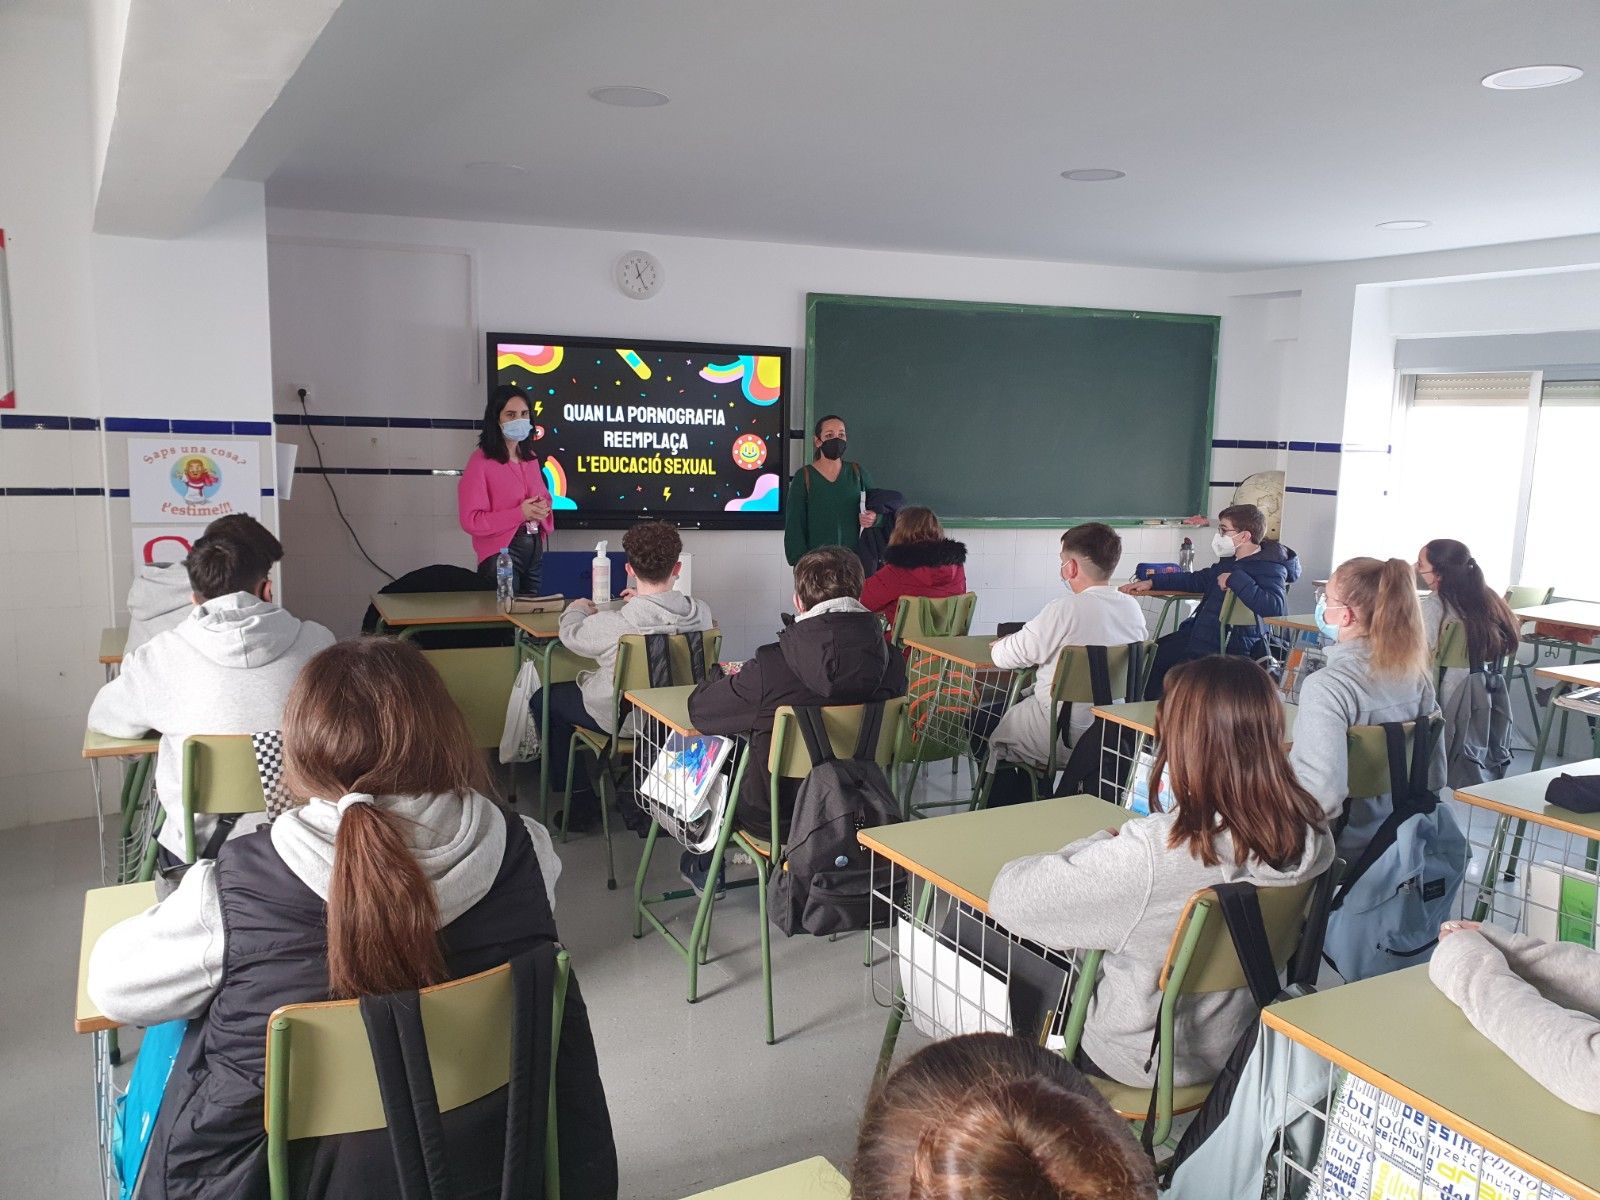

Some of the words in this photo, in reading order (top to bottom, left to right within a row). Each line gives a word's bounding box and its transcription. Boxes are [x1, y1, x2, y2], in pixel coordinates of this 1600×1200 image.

[564, 404, 603, 422] QUAN
[606, 405, 625, 423] LA
[628, 407, 726, 426] PORNOGRAFIA
[603, 431, 689, 456] REEMPLAÇA
[142, 446, 176, 465] Saps
[180, 446, 206, 454] una
[664, 459, 716, 475] SEXUAL
